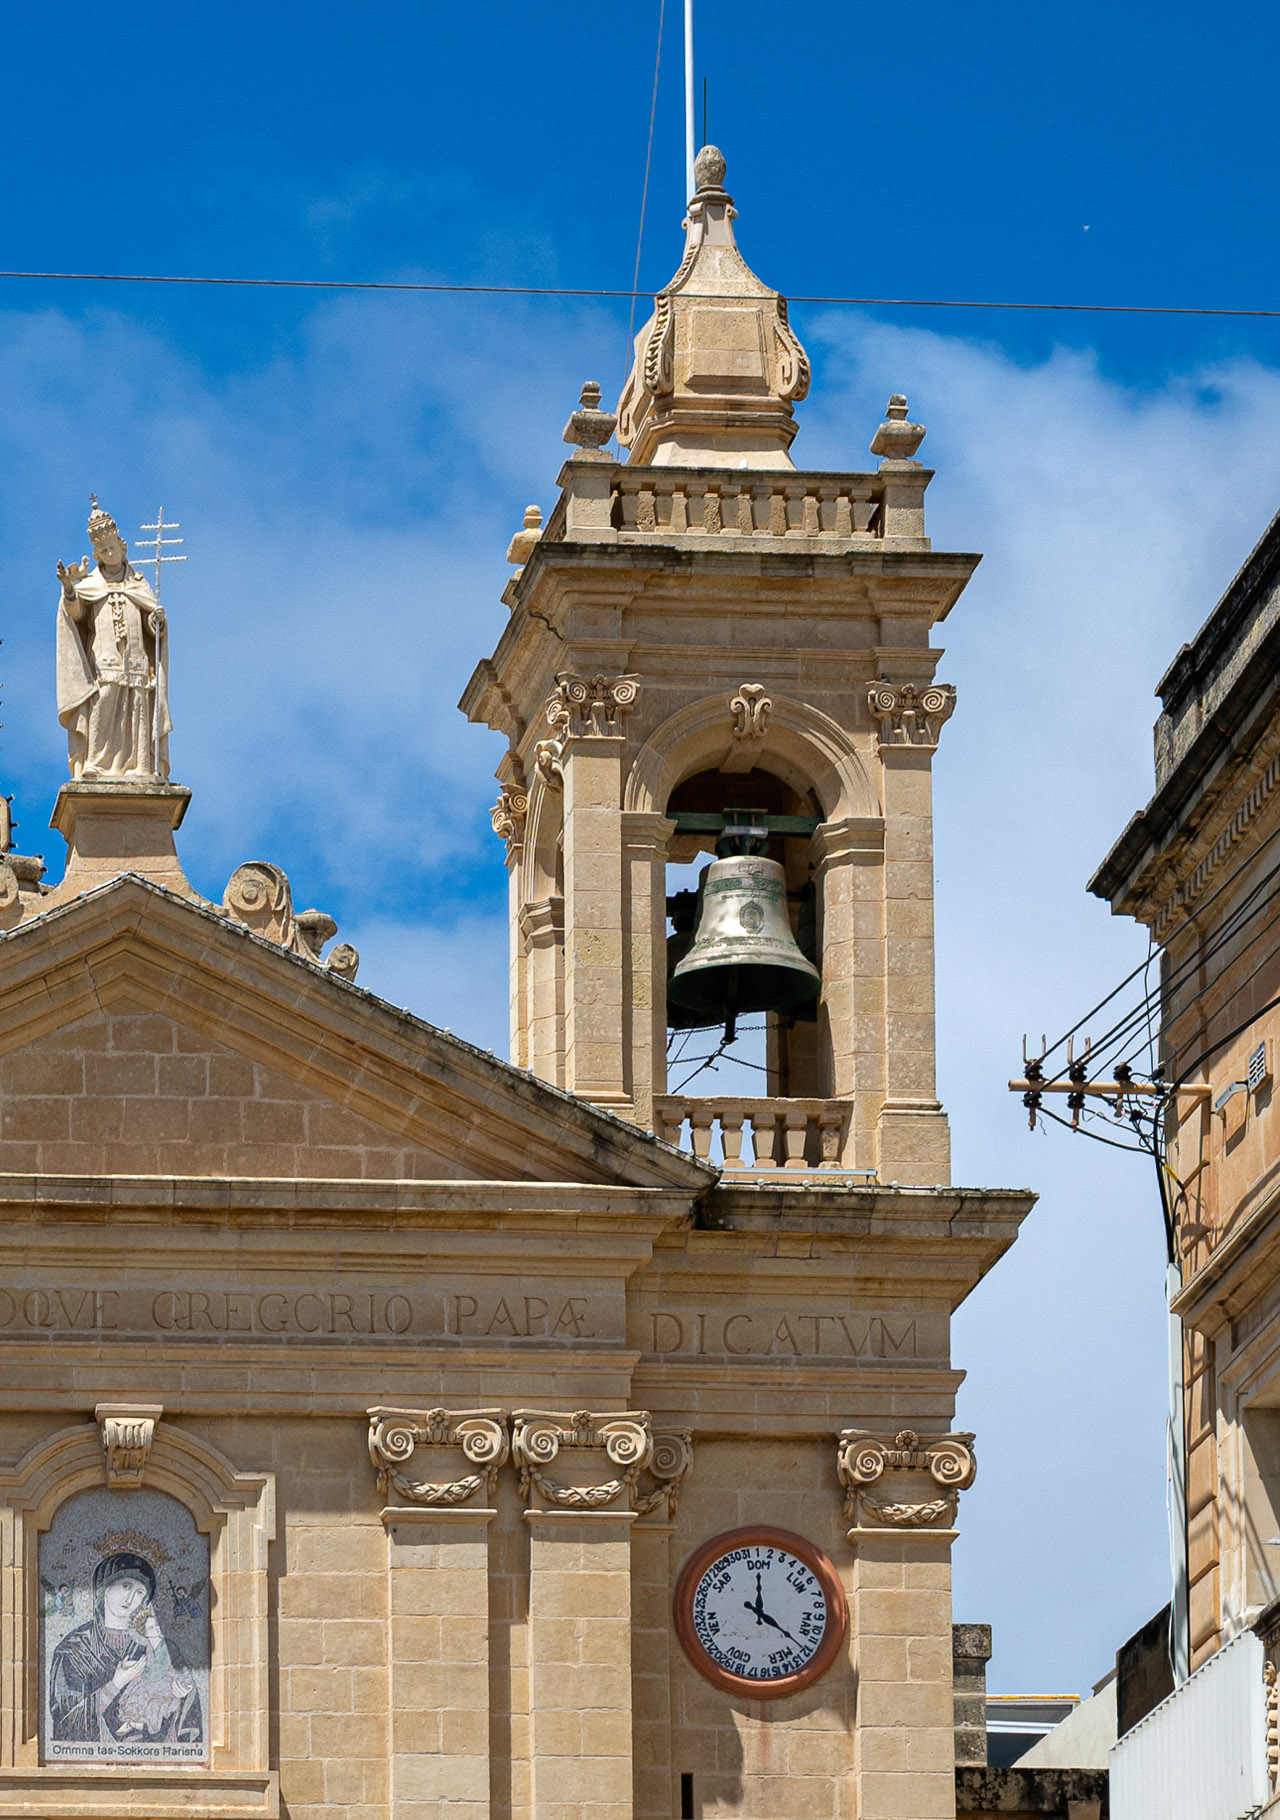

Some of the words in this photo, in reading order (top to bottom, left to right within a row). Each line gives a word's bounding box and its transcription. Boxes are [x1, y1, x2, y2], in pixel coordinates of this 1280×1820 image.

[151, 1290, 414, 1335] GREGORIO
[450, 1294, 596, 1338] PAPÆ
[650, 1311, 920, 1359] DICATVM
[728, 1553, 740, 1562] 30
[741, 1549, 750, 1559] 31
[756, 1548, 760, 1557] 1
[767, 1549, 774, 1559] 2
[778, 1553, 786, 1563] 3
[719, 1557, 730, 1569] 29
[747, 1561, 770, 1570] DOM
[788, 1560, 797, 1568] 4
[709, 1564, 721, 1578] 28
[798, 1566, 807, 1576] 5
[702, 1573, 714, 1588] 27
[713, 1573, 732, 1594] SAB
[786, 1573, 807, 1594] LUN
[806, 1576, 815, 1585] 6
[697, 1584, 710, 1598] 26
[811, 1590, 822, 1598] 7
[696, 1598, 706, 1609] 25
[708, 1612, 721, 1636] VEN
[799, 1612, 812, 1636] MAR
[812, 1625, 823, 1635] 10
[809, 1637, 819, 1645] 11
[726, 1646, 751, 1662] GIOV
[769, 1646, 794, 1664] MER
[800, 1646, 813, 1657] 12
[791, 1654, 806, 1667] 13
[772, 1666, 782, 1676] 15
[783, 1663, 795, 1672] 14
[53, 1745, 94, 1755] Ommna
[98, 1746, 159, 1756] tas-Sokkors
